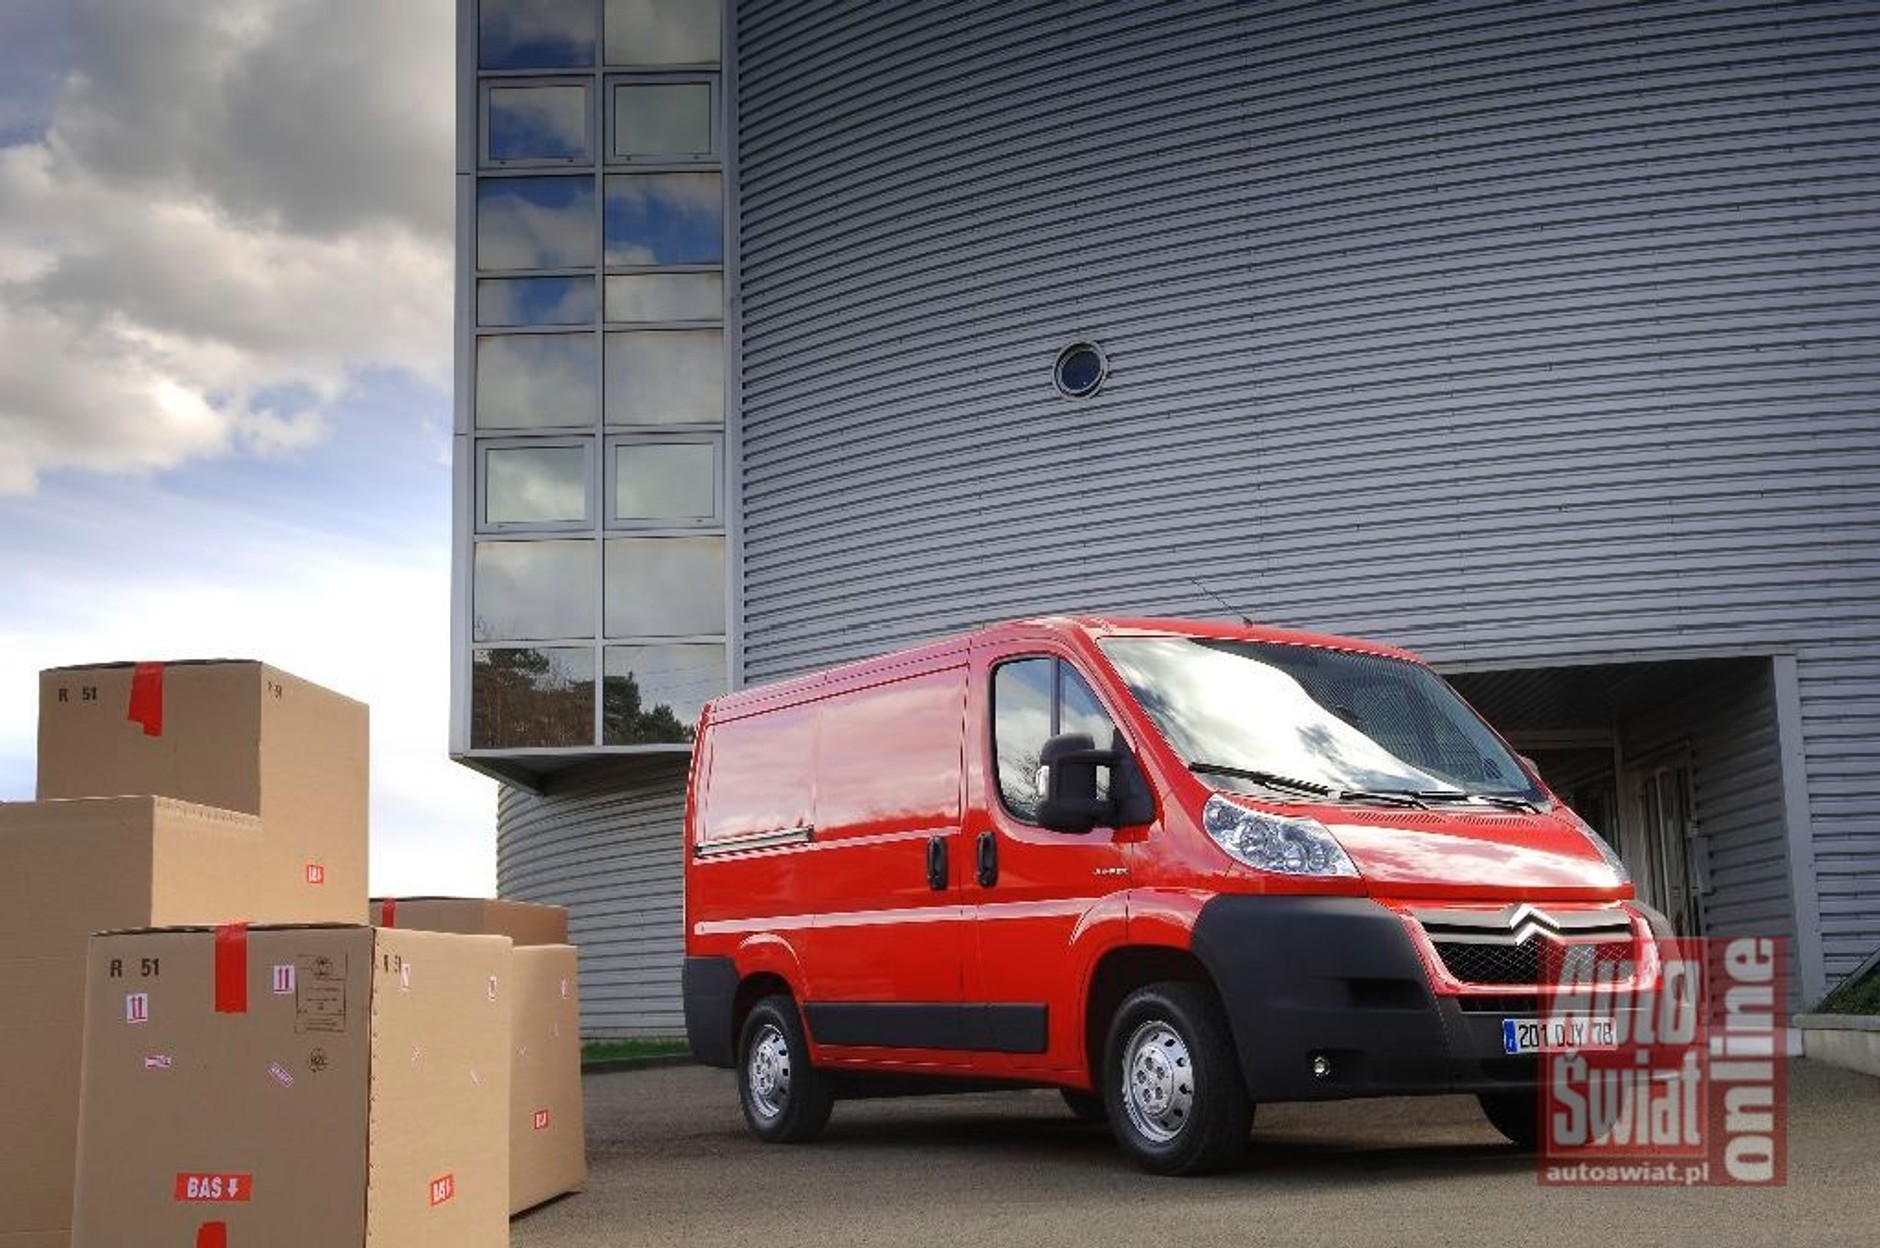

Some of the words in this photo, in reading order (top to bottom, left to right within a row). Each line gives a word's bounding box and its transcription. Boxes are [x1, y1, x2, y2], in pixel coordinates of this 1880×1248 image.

[59, 687, 69, 702] R
[82, 686, 97, 701] 51
[110, 959, 123, 977] R
[141, 958, 159, 977] 51
[1518, 1024, 1549, 1048] 201
[187, 1176, 221, 1198] BAS
